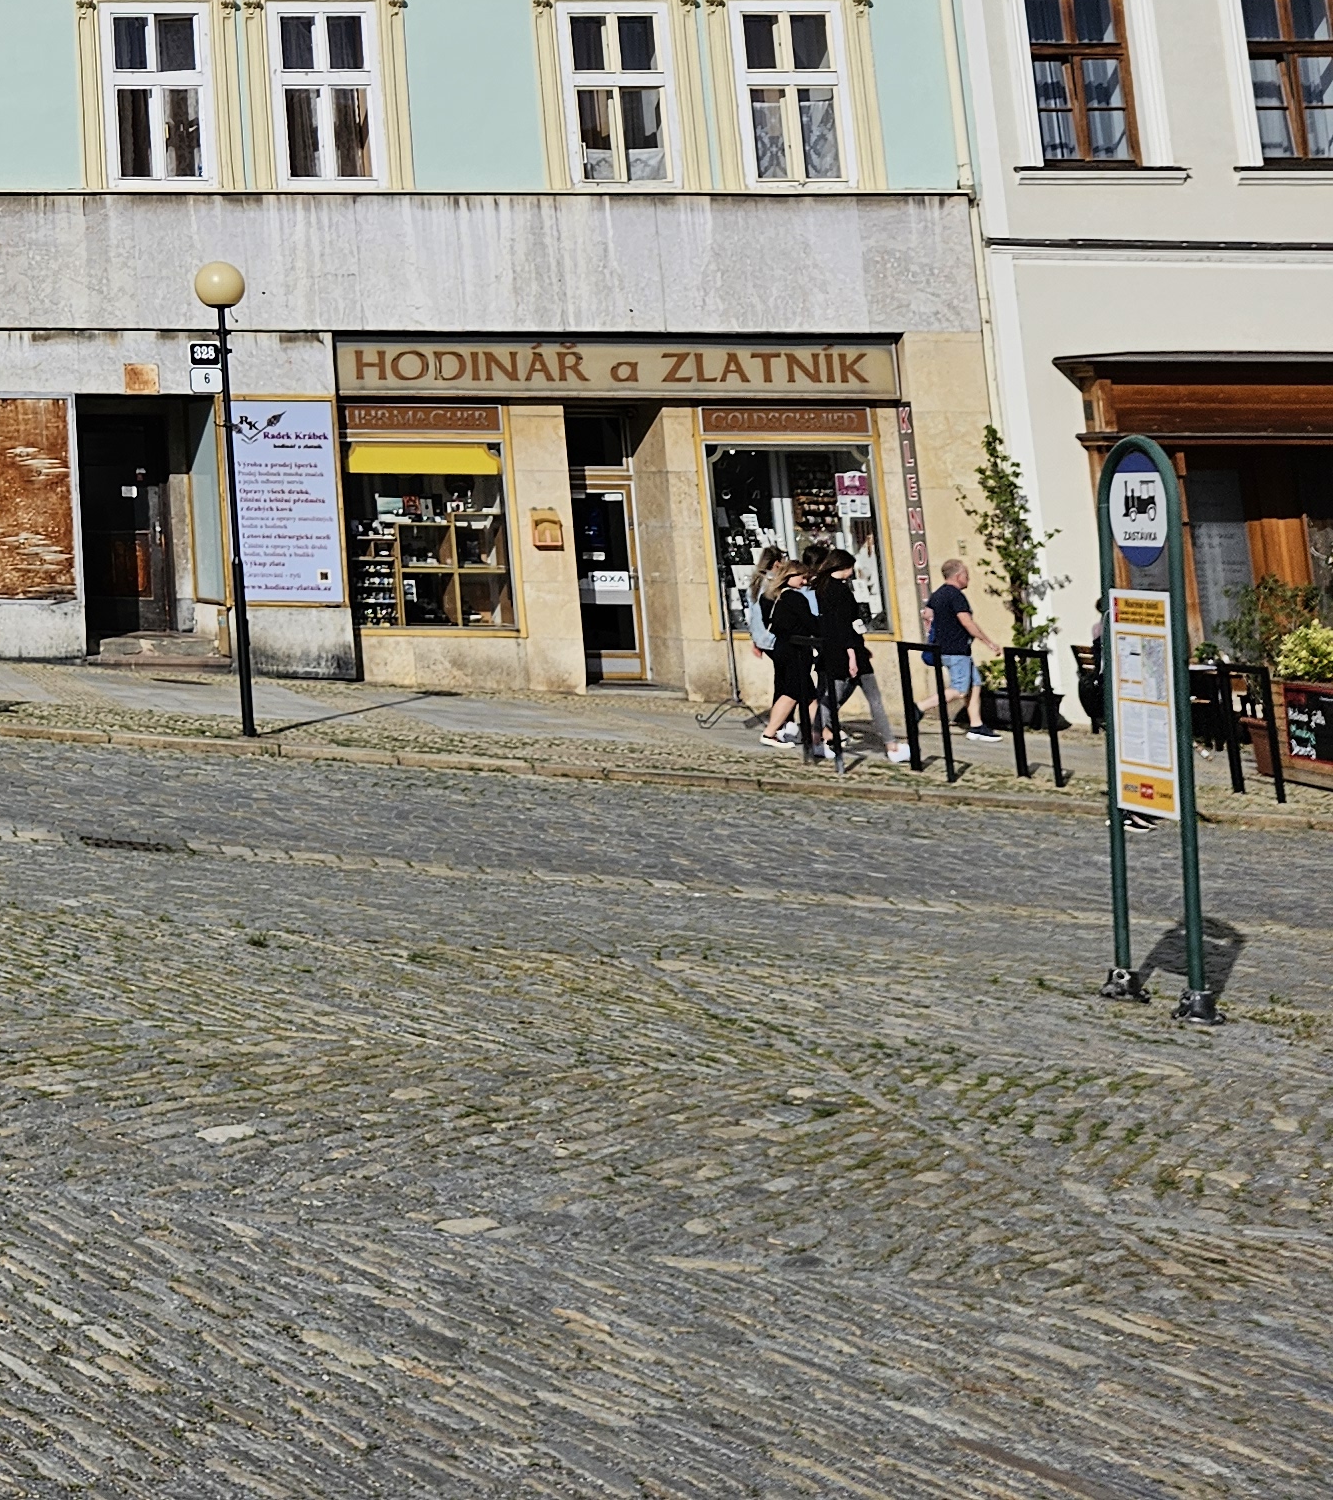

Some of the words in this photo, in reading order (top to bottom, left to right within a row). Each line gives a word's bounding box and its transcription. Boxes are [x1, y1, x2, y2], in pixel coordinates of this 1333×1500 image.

[193, 346, 216, 359] 328
[354, 342, 591, 382] HODINÁŘ
[610, 361, 639, 382] a
[661, 344, 869, 383] ZLATNÍK
[204, 373, 211, 384] 6
[345, 409, 490, 427] UHRMACHER
[711, 412, 859, 429] GOLDSCHMIED
[263, 431, 292, 440] Radek
[295, 431, 329, 440] Krábek
[591, 574, 625, 583] DOXA
